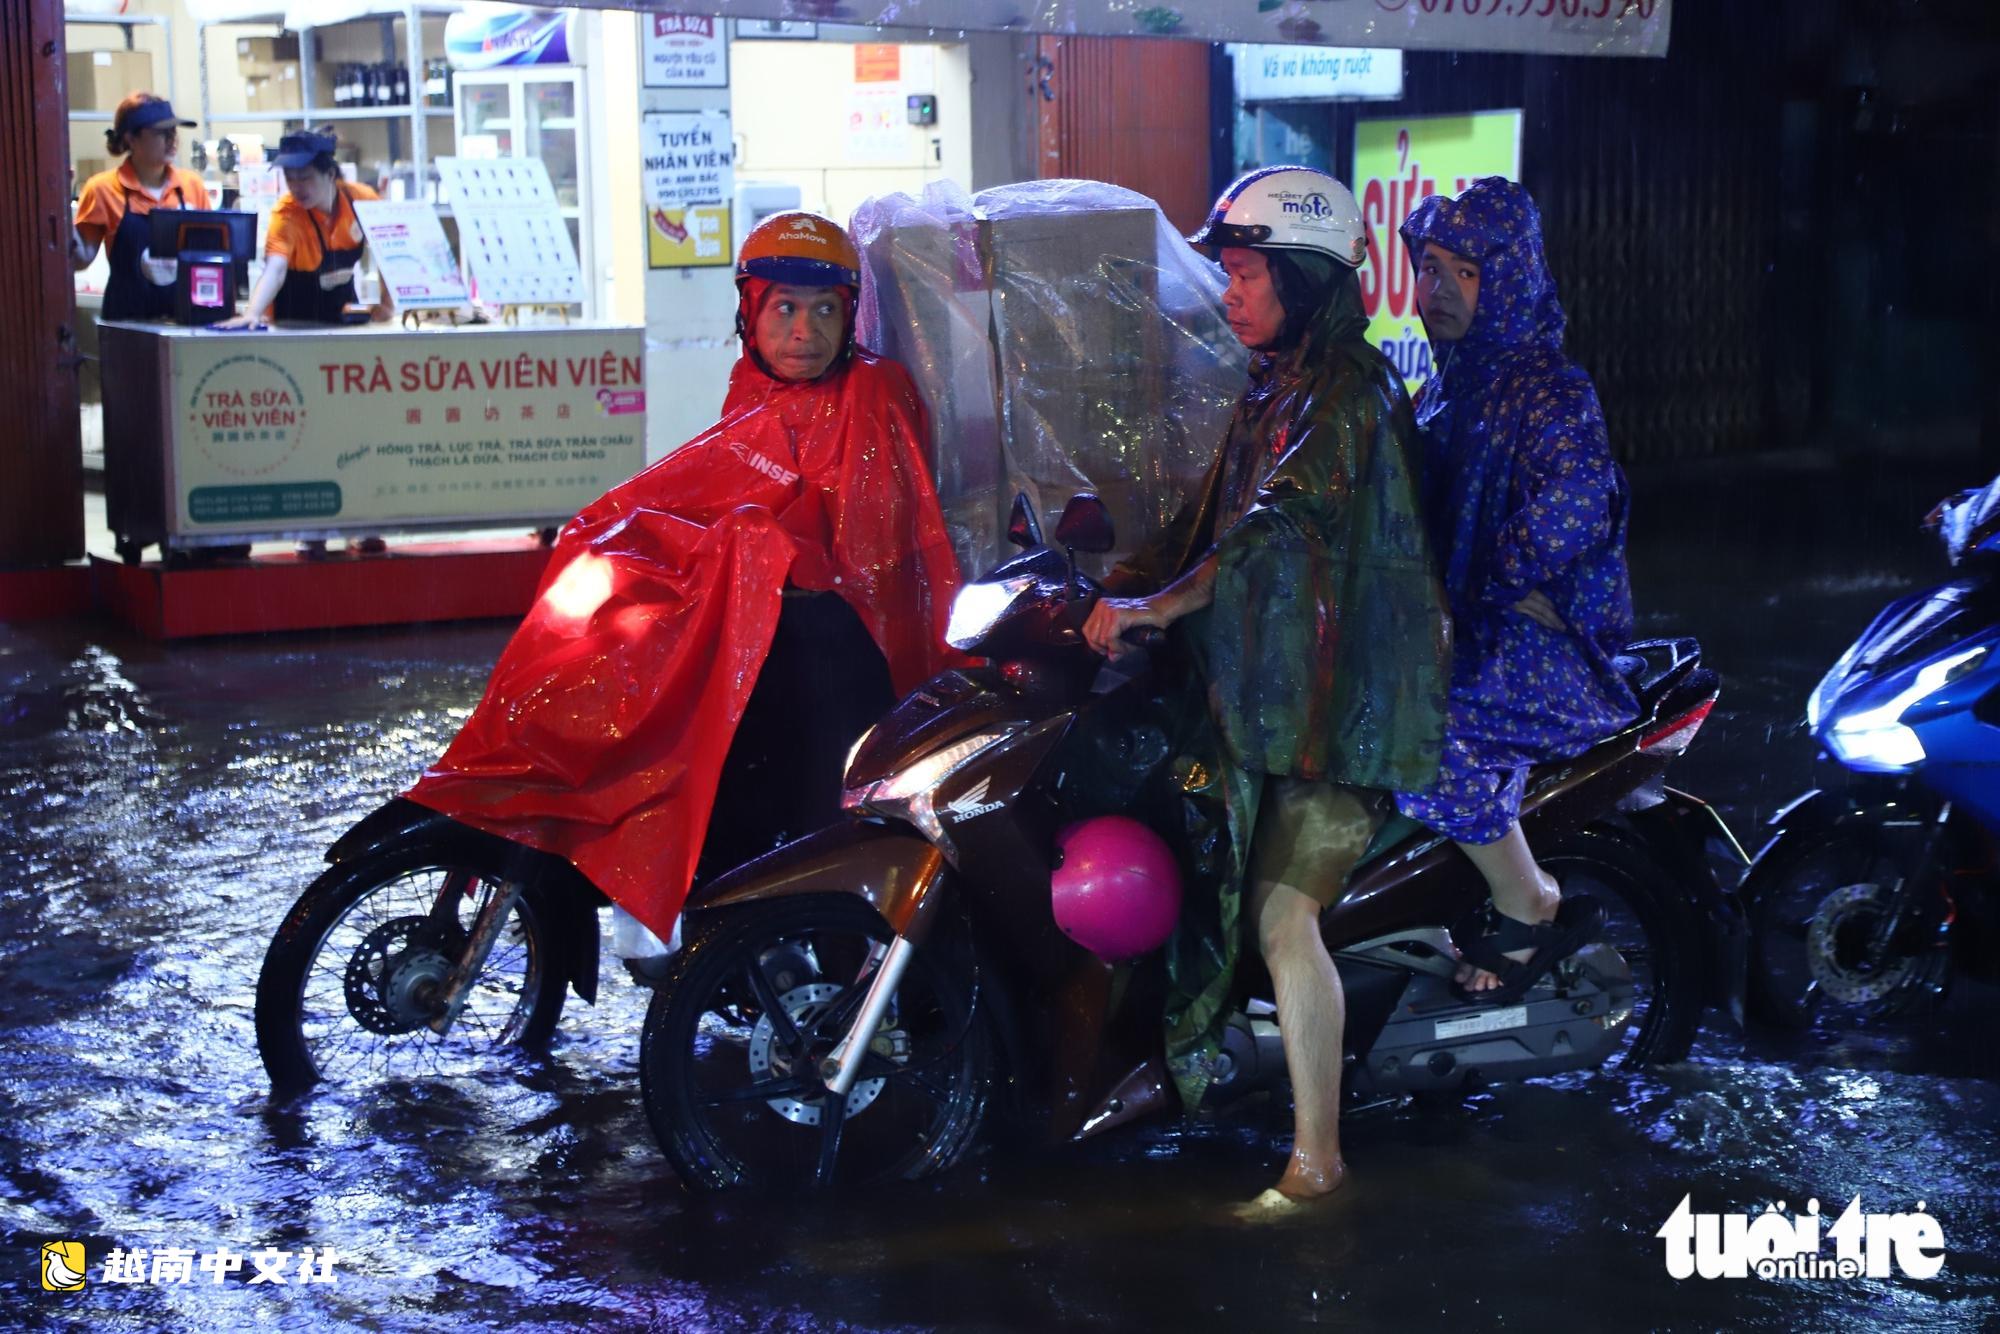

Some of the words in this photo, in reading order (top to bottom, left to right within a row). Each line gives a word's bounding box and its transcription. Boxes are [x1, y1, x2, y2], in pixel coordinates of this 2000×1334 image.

[1300, 52, 1341, 80] không
[1343, 49, 1373, 78] ruột
[645, 152, 688, 171] NHÂN
[693, 148, 731, 168] VIÊN
[1283, 196, 1332, 217] moto
[778, 230, 827, 246] AhaMove
[319, 357, 392, 394] TRÀ
[400, 356, 476, 392] SỮA
[480, 353, 558, 391] VIÊN
[566, 350, 641, 386] VIÊN
[206, 389, 245, 408] TRÀ
[250, 388, 292, 407] SỮA
[202, 410, 247, 429] VIÊN
[252, 408, 296, 427] VIÊN
[749, 452, 800, 486] INSE
[952, 801, 1006, 824] HONDA
